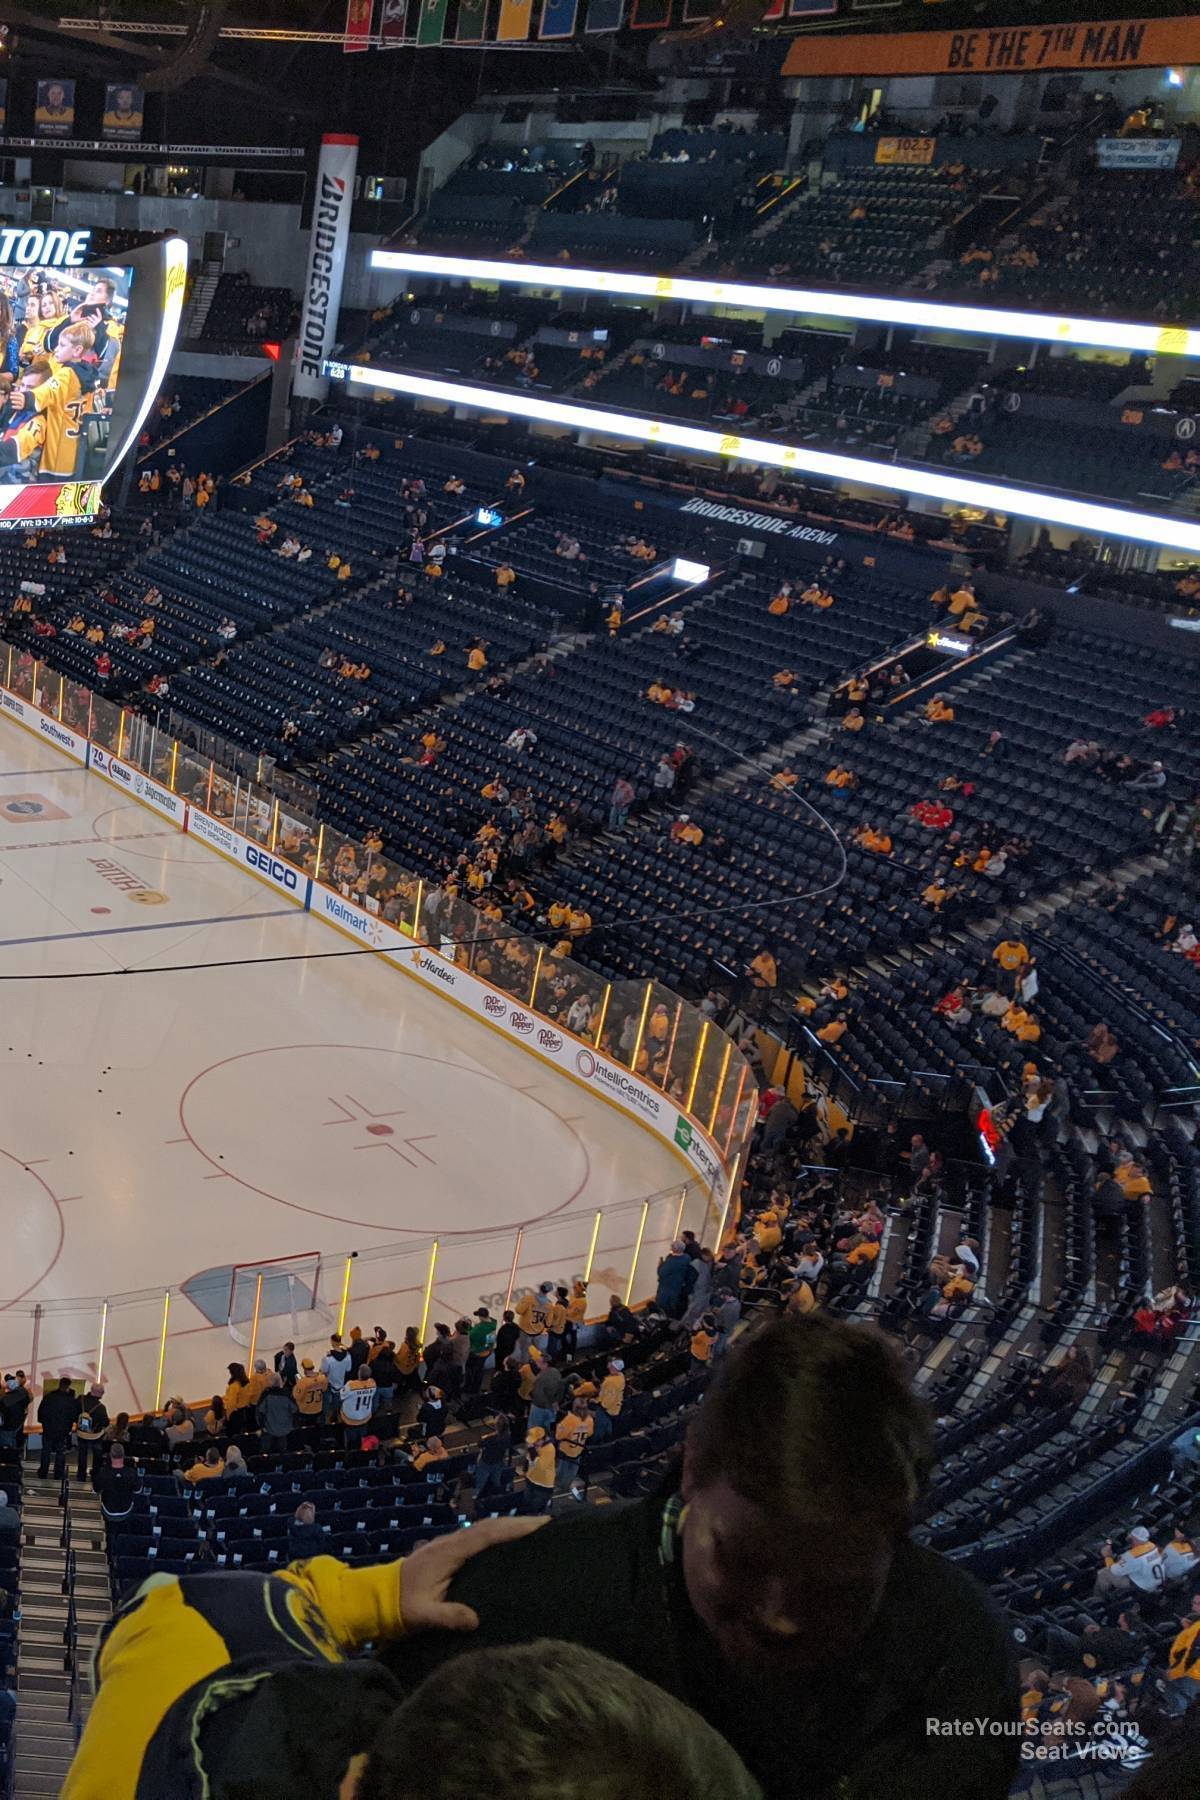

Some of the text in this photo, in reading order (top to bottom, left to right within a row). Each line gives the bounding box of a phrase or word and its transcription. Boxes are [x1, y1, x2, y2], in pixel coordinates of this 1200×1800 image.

[948, 24, 1146, 68] BE THE 7TH MAN
[300, 172, 346, 379] BRIDGESTONE
[680, 497, 839, 545] BRIDGESTONE ARENA
[40, 718, 73, 748] Southwest
[194, 812, 232, 842] BRENTWOOD
[246, 845, 297, 890] GEICO
[326, 895, 368, 934] Walmart
[484, 995, 506, 1014] Pepper
[510, 1012, 534, 1031] Pepper
[538, 1029, 562, 1048] Pepper
[595, 1061, 660, 1113] IntelliCentrics
[355, 1395, 372, 1411] 14
